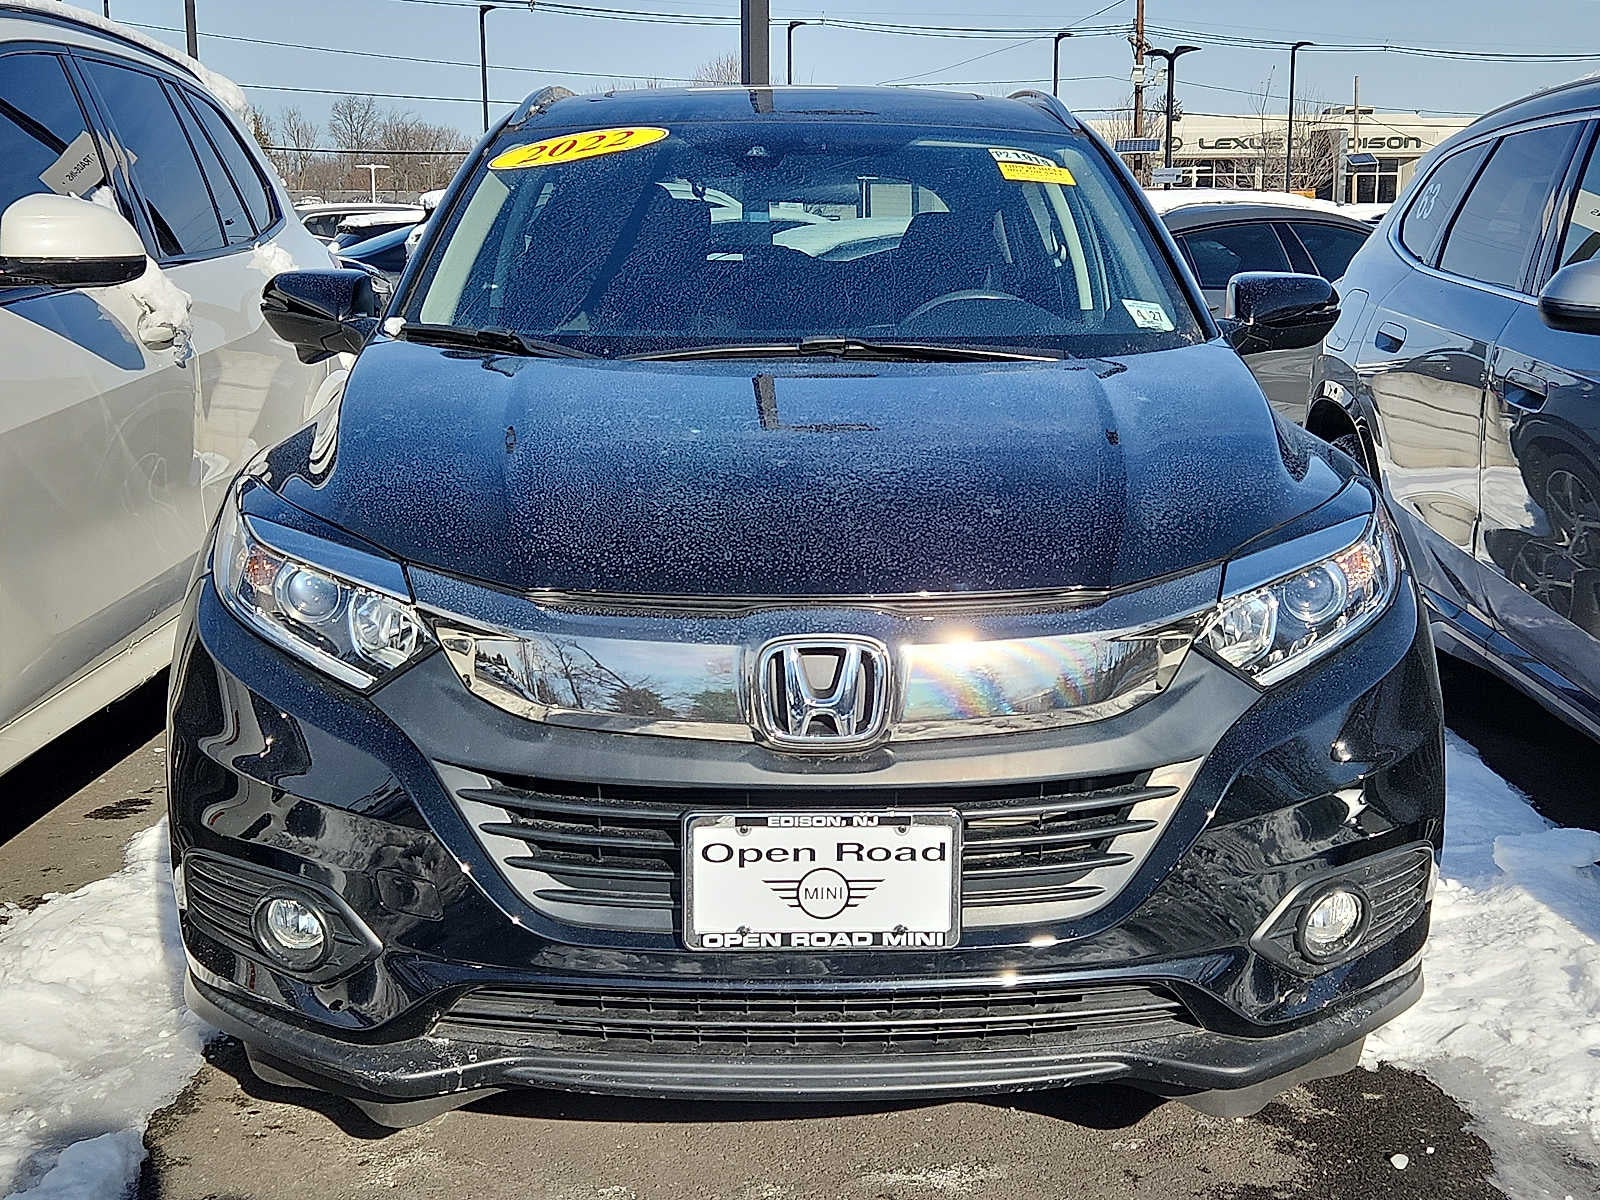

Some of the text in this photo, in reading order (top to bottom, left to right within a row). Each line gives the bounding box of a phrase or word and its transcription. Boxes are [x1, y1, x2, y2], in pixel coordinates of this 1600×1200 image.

[518, 131, 634, 164] 2022
[1198, 137, 1283, 150] LEXUS
[1346, 136, 1422, 149] DISON
[1148, 310, 1164, 322] 27
[767, 815, 879, 828] EDISON, NJ
[701, 841, 946, 868] Open Road
[803, 886, 844, 901] MINI
[702, 932, 945, 948] OPEN ROAD MINI
